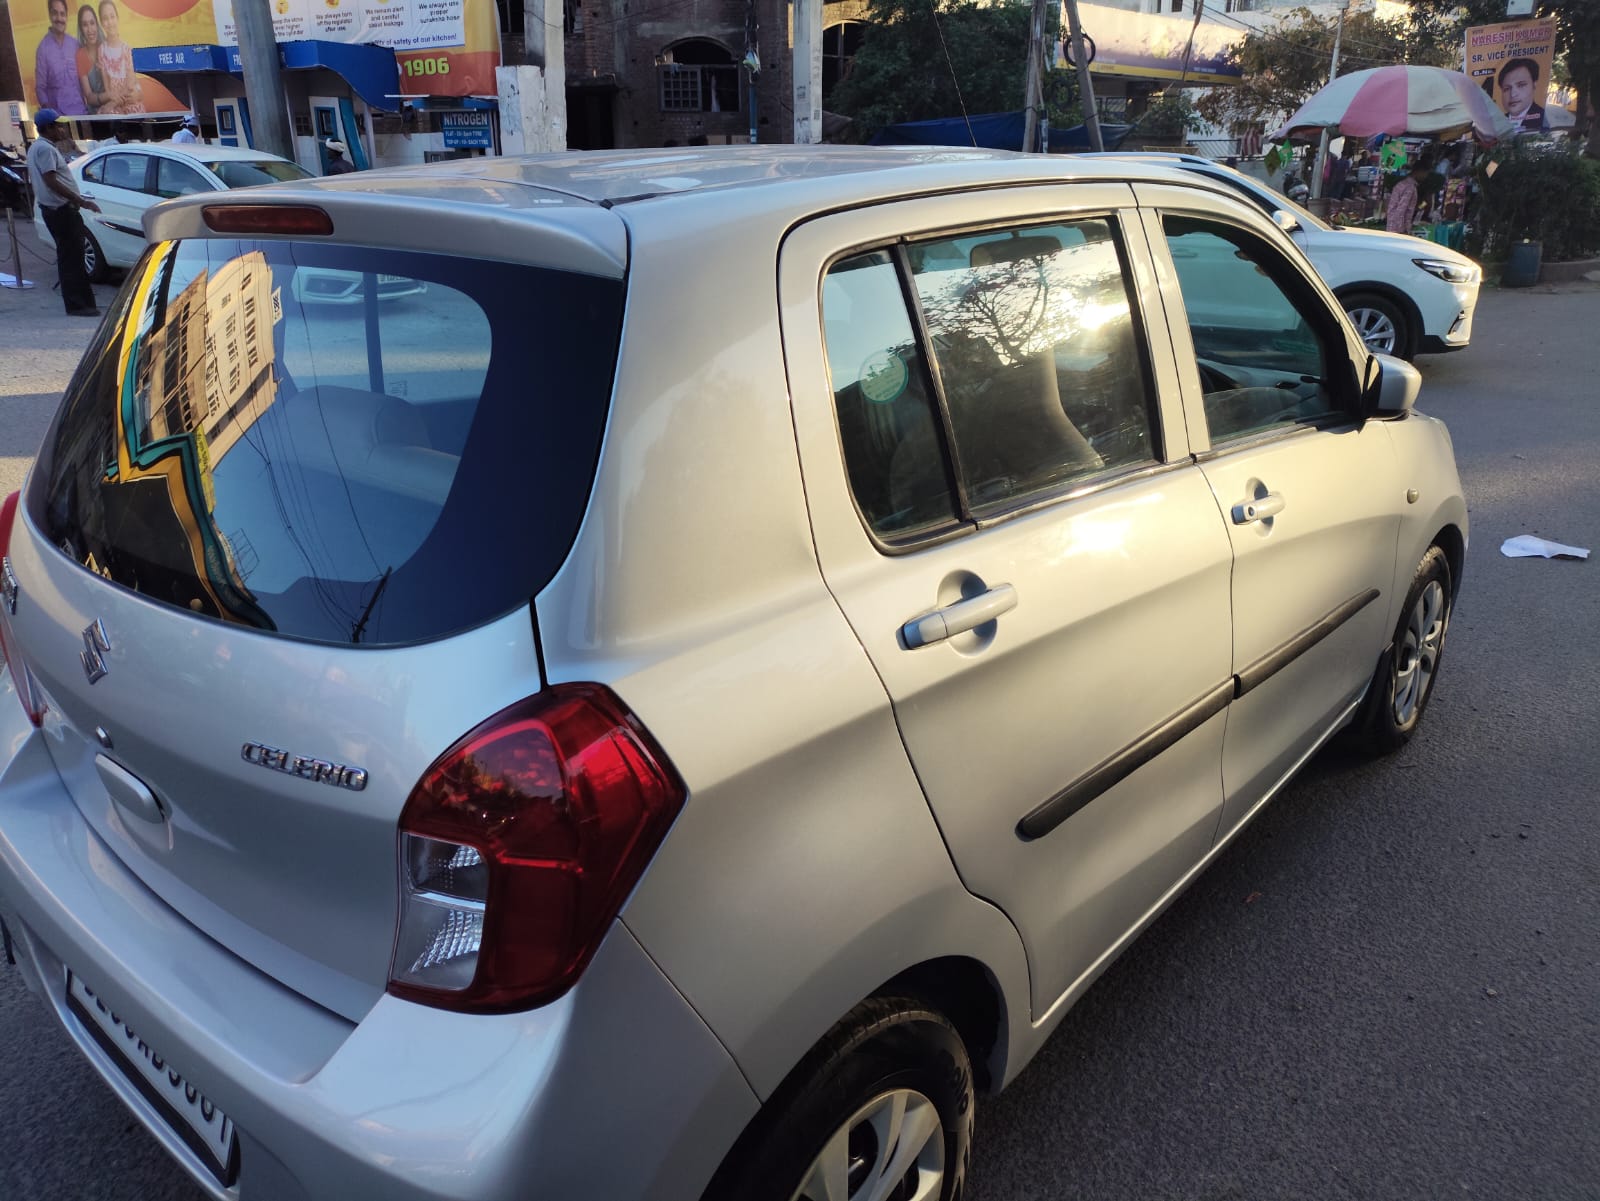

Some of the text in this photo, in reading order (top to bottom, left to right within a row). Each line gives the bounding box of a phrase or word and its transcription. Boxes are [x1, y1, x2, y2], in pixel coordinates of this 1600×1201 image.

[393, 37, 411, 45] safety
[1471, 32, 1512, 46] NARESH
[158, 52, 185, 65] FREE AIR
[1472, 45, 1549, 63] SR. VICE PRESIDENT
[403, 57, 450, 77] 1906
[443, 112, 488, 126] NITROGEN
[240, 739, 369, 793] CELERIO
